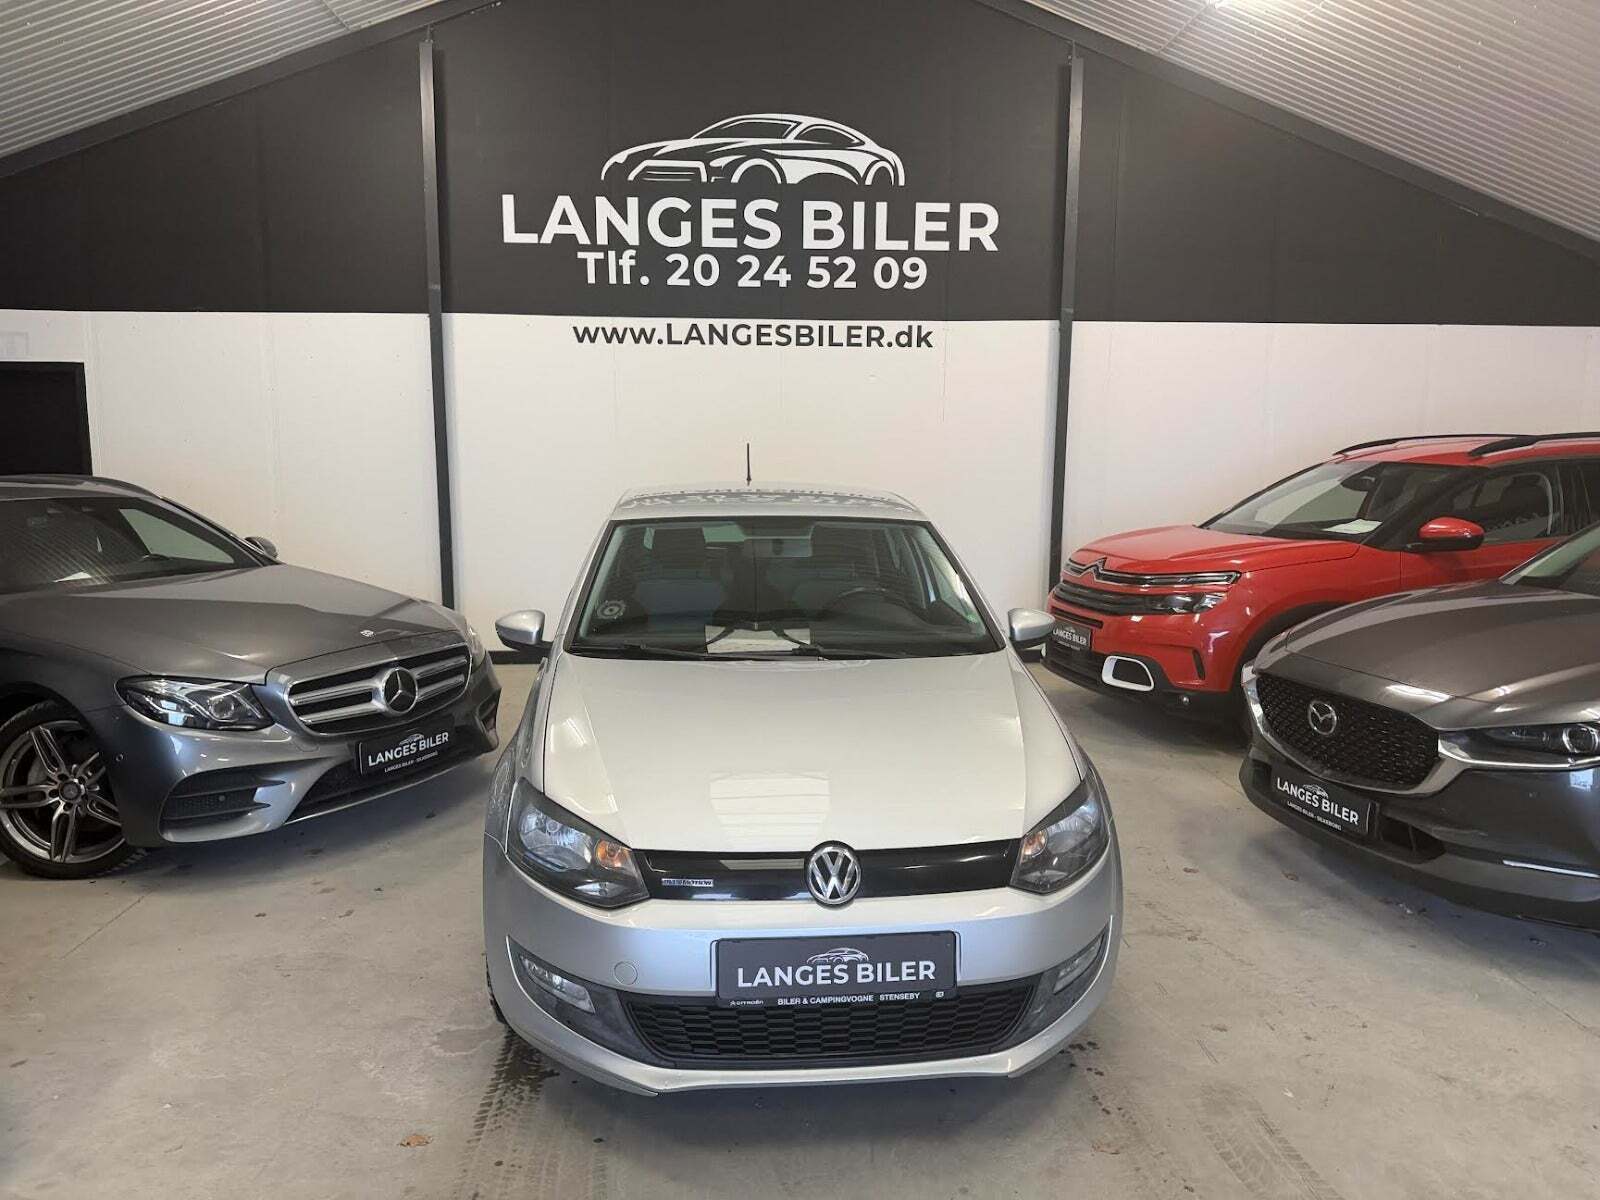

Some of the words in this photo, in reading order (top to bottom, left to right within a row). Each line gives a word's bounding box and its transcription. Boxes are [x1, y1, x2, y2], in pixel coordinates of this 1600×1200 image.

[501, 194, 782, 249] LANGES
[802, 200, 999, 251] BILER
[577, 250, 650, 286] Tlf.
[665, 253, 720, 287] 20
[736, 254, 792, 288] 24
[806, 255, 857, 289] 52
[873, 256, 928, 290] 09
[572, 323, 933, 348] www.LANGESBILER.dk
[368, 743, 417, 766] LANGES
[418, 732, 449, 751] BILER
[1276, 777, 1320, 807] LANGES
[1321, 799, 1359, 825] BILER
[737, 964, 849, 988] LANGES
[856, 960, 936, 983] BILER
[802, 997, 809, 1005] &
[810, 995, 874, 1004] CAMPINGVOGNE
[879, 992, 920, 1001] STENSEBY
